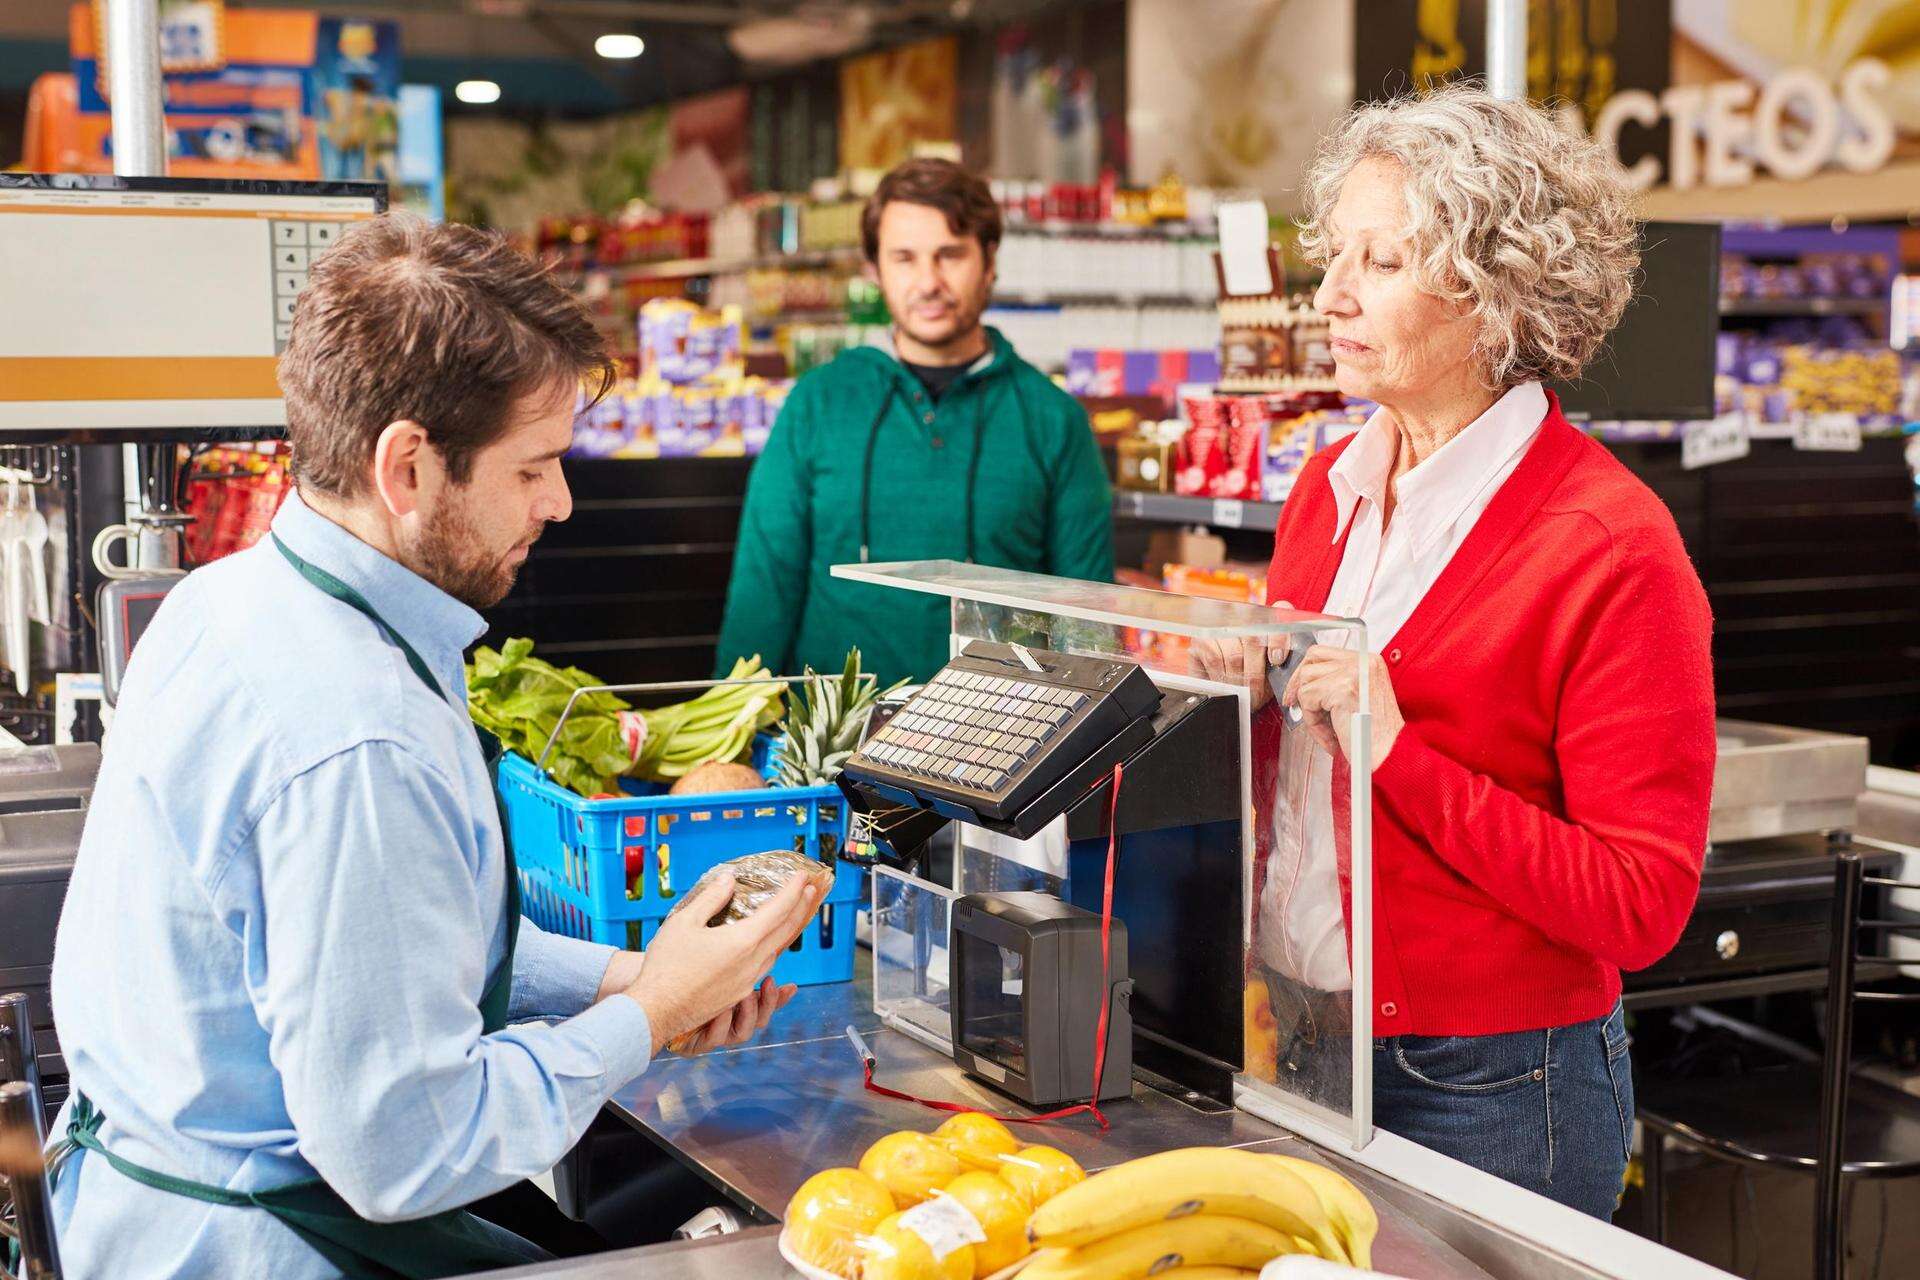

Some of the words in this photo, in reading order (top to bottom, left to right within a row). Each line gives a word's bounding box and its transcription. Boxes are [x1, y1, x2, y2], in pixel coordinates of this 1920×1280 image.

[1556, 57, 1897, 191] CTEOS
[285, 228, 294, 238] 7
[319, 229, 328, 239] 8
[286, 253, 296, 263] 4
[289, 279, 296, 289] 1
